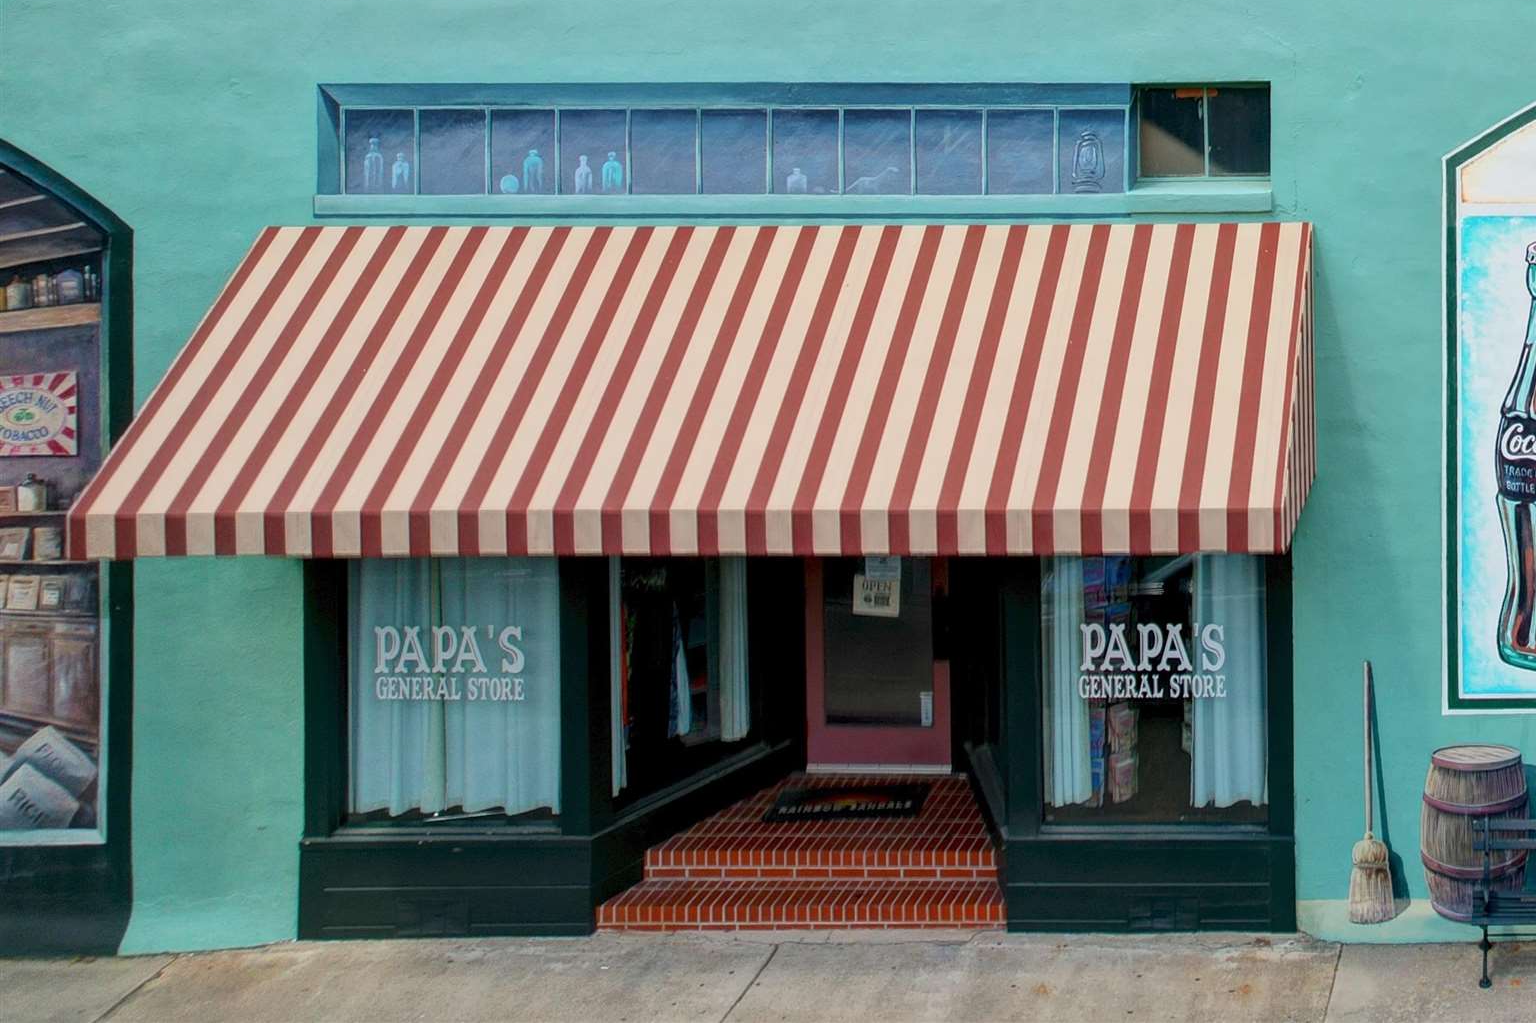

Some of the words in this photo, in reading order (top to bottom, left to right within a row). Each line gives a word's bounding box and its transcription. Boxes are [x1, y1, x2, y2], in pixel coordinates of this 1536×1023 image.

[1506, 480, 1535, 494] BOTTLE
[374, 625, 525, 674] PAPA'S
[1080, 622, 1226, 672] PAPA'S
[375, 677, 461, 700] GENERAL
[467, 677, 525, 700] STORE
[1078, 674, 1164, 698] GENERAL
[1169, 674, 1227, 698] STORE
